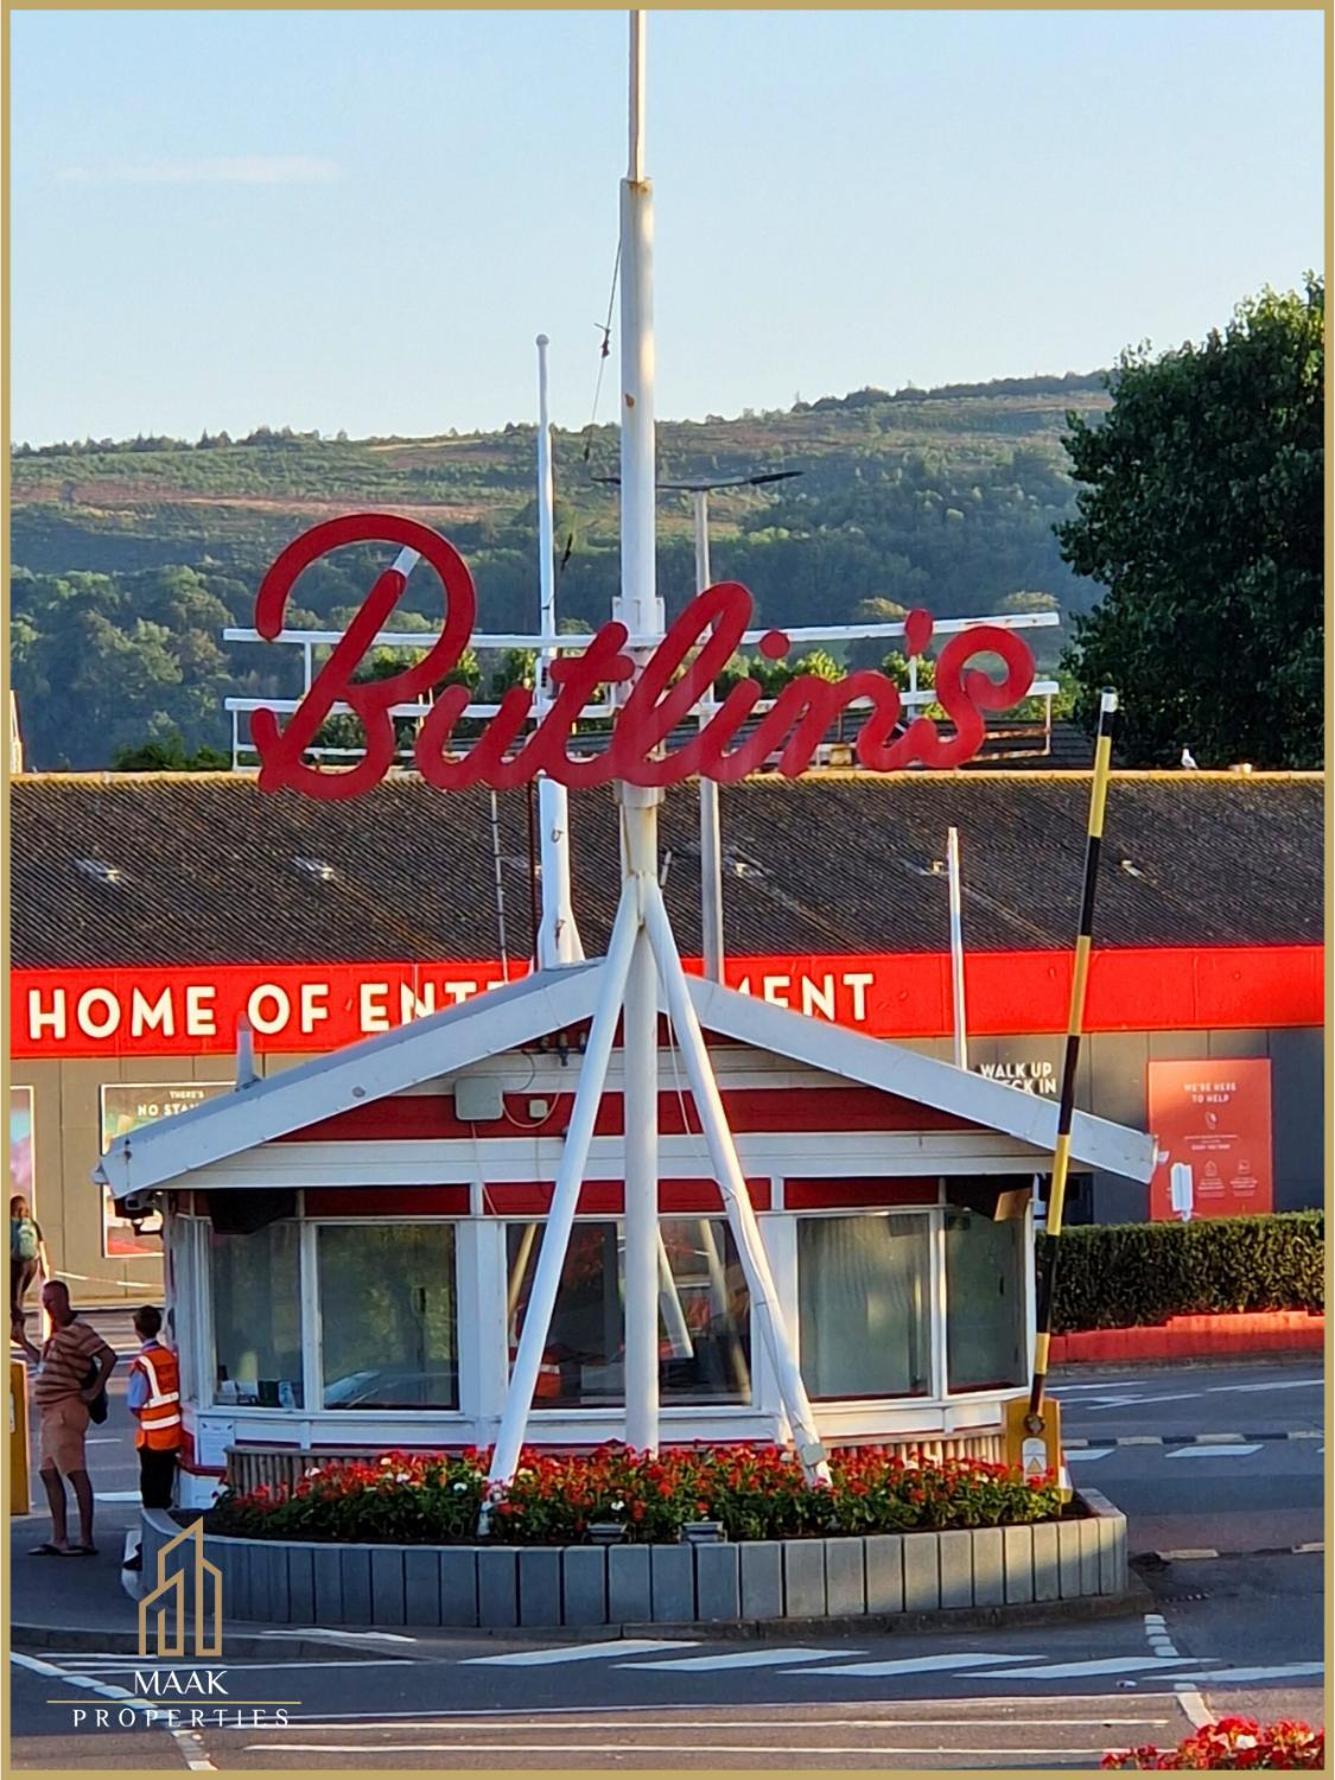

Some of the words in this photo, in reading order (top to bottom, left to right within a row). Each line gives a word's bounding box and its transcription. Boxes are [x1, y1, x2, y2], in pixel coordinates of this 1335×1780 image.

[251, 513, 1035, 799] Butlin's
[28, 986, 216, 1039] HOME
[247, 982, 329, 1035] OF
[980, 1063, 1026, 1079] WALK
[1031, 1061, 1052, 1077] UP
[1039, 1078, 1057, 1094] IN
[1192, 1093, 1204, 1103] TO
[1206, 1093, 1230, 1103] HELP
[137, 1104, 159, 1116] NO
